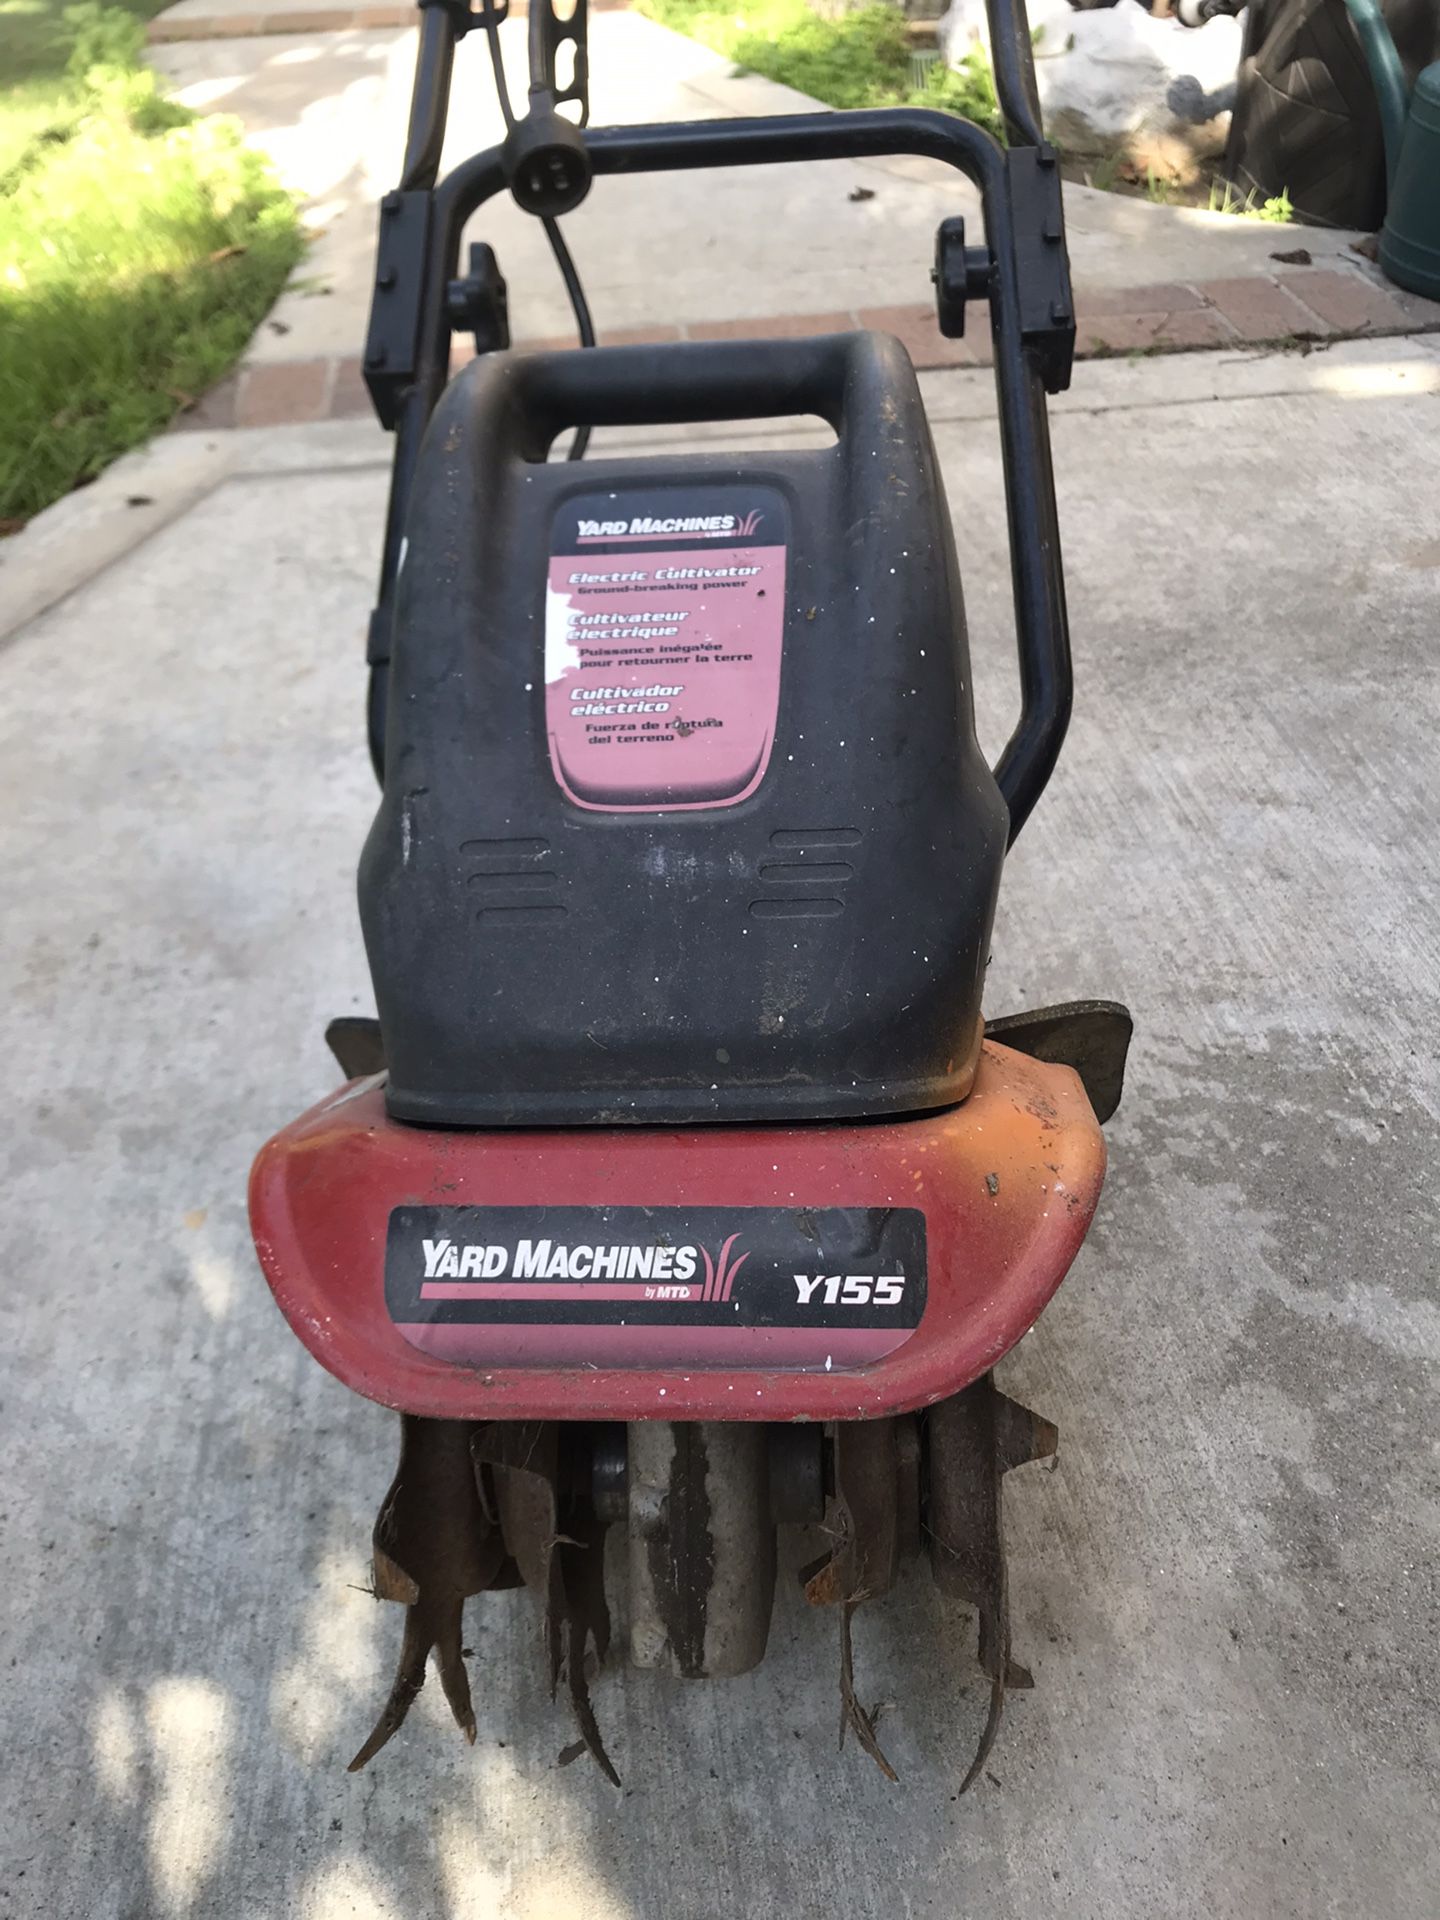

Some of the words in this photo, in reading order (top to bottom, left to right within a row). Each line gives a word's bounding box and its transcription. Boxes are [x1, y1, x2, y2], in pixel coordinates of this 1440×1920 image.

[577, 520, 627, 536] YARD
[629, 515, 735, 534] MACHINES
[568, 570, 648, 584] Electric
[654, 565, 762, 580] Cultivator
[577, 583, 698, 595] Ground-breaking
[702, 580, 748, 591] power
[567, 612, 689, 626] Cultivateur
[580, 647, 655, 656] Puissance
[580, 660, 613, 669] pour
[618, 656, 690, 666] retourner
[714, 654, 753, 662] terre
[570, 685, 684, 701] Cultivador
[570, 701, 670, 717] eléctrico
[585, 722, 636, 732] Fuerza
[641, 721, 660, 730] de
[589, 735, 612, 744] del
[617, 734, 674, 743] terreno
[421, 1239, 508, 1278] YARD
[512, 1239, 697, 1279] MACHINES
[645, 1286, 656, 1299] by
[657, 1286, 690, 1298] MTD
[793, 1275, 905, 1305] Y155
